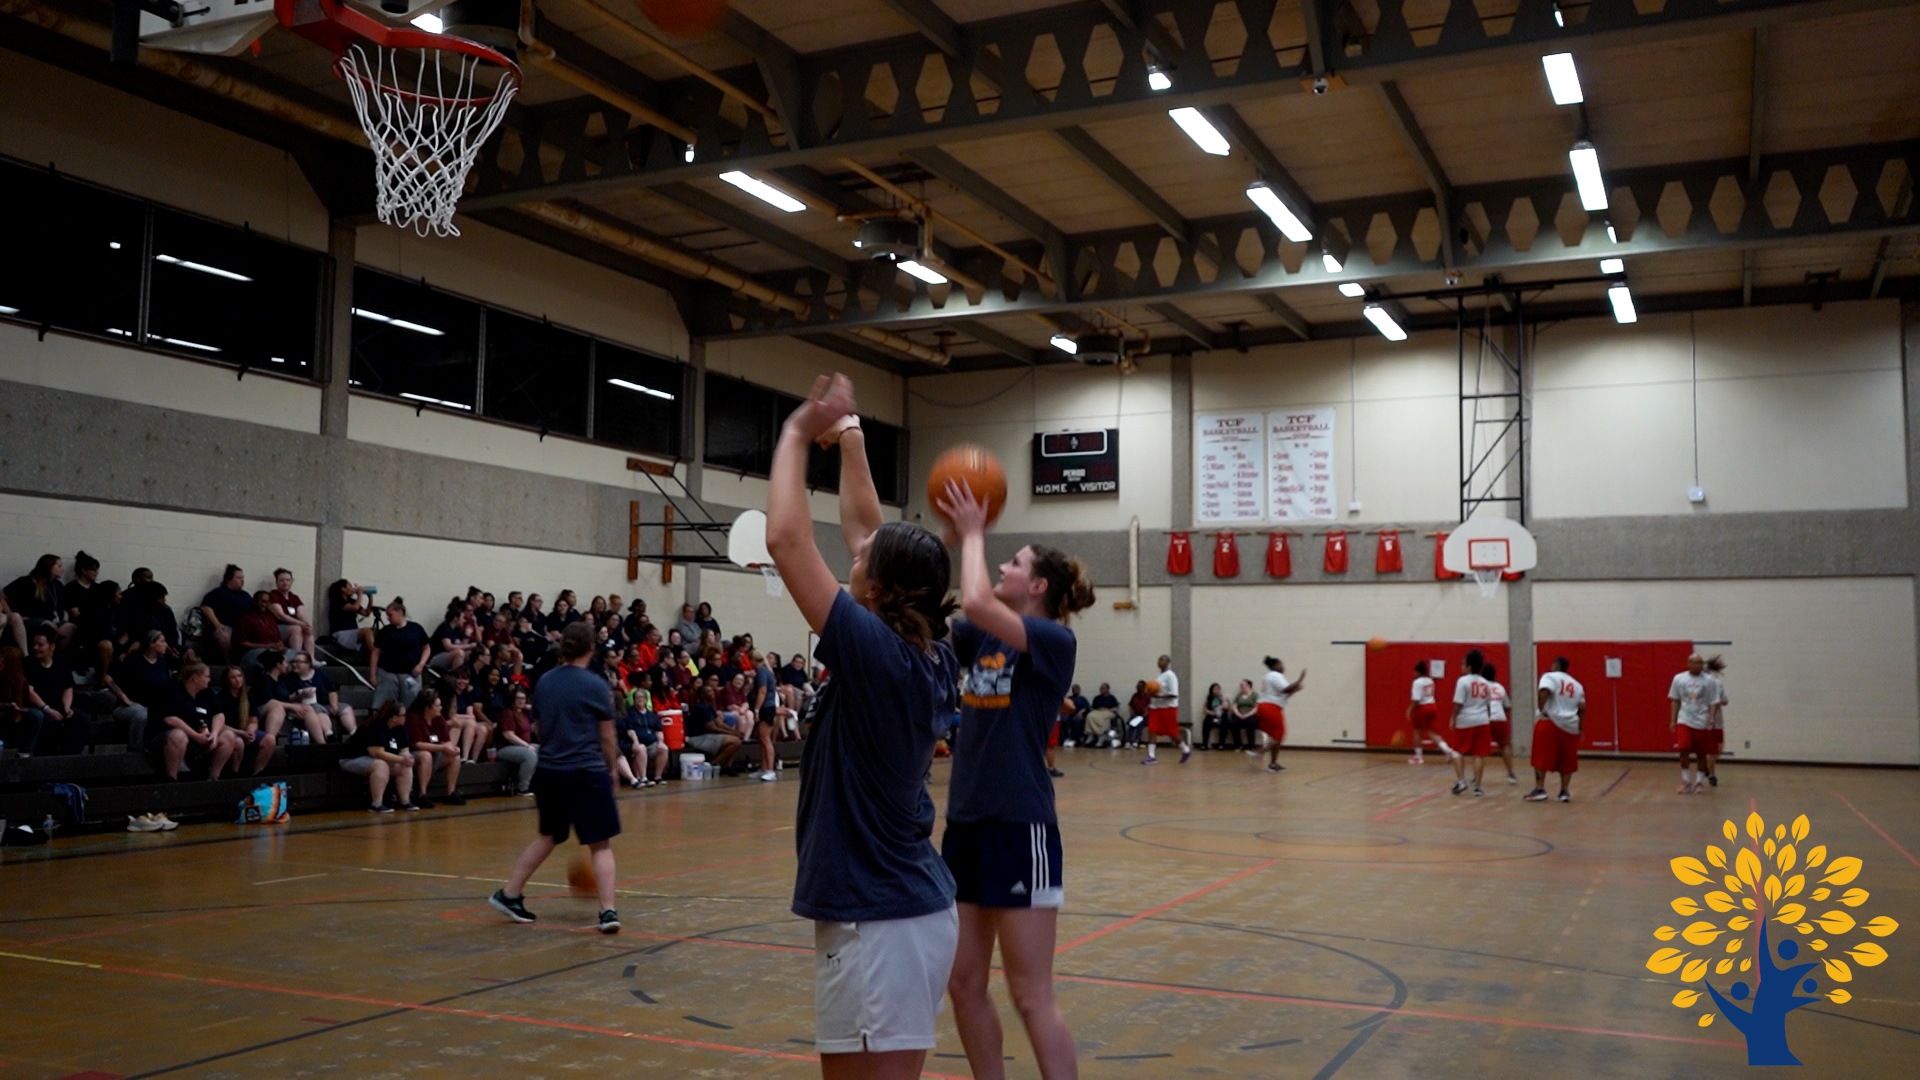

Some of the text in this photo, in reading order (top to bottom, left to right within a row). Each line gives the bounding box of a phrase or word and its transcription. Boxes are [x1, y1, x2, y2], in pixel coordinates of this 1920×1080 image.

[1217, 418, 1245, 427] TCF
[1287, 415, 1317, 424] TCF
[1203, 427, 1259, 436] BASKETBALL
[1272, 424, 1330, 433] BASKETBALL
[1036, 481, 1116, 494] HOME VISITOR
[1221, 542, 1230, 553] 2
[1559, 679, 1575, 698] 14
